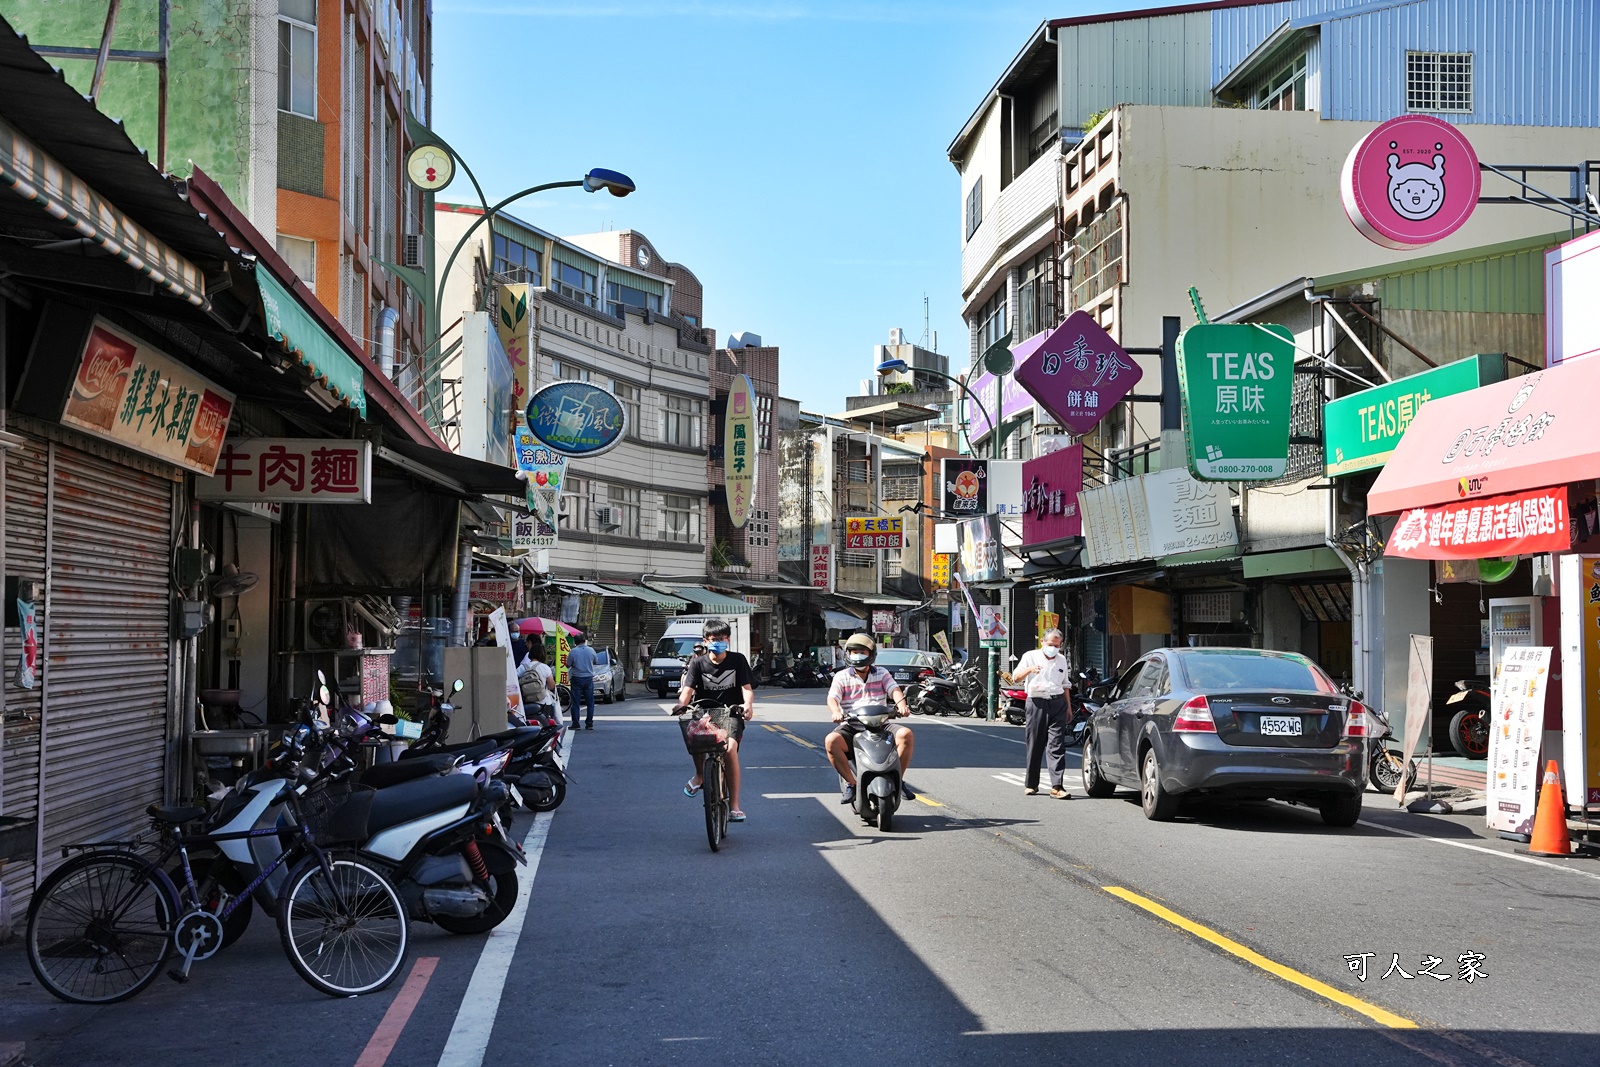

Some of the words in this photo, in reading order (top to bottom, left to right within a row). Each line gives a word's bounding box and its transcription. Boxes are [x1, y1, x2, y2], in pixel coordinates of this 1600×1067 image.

[1041, 334, 1131, 386] 日香珍
[1207, 352, 1275, 380] TEA'S
[1215, 385, 1265, 414] 原味
[521, 449, 564, 465] 冷熱飲
[733, 424, 747, 473] 風信子
[214, 444, 360, 494] 牛肉麵
[1218, 465, 1273, 473] 0800-270-008
[734, 482, 745, 517] 美食坊
[865, 519, 901, 531] 天橋下
[521, 538, 554, 546] 2641317
[849, 534, 900, 548] 火雞肉飯
[813, 556, 828, 587] 火雞肉飯
